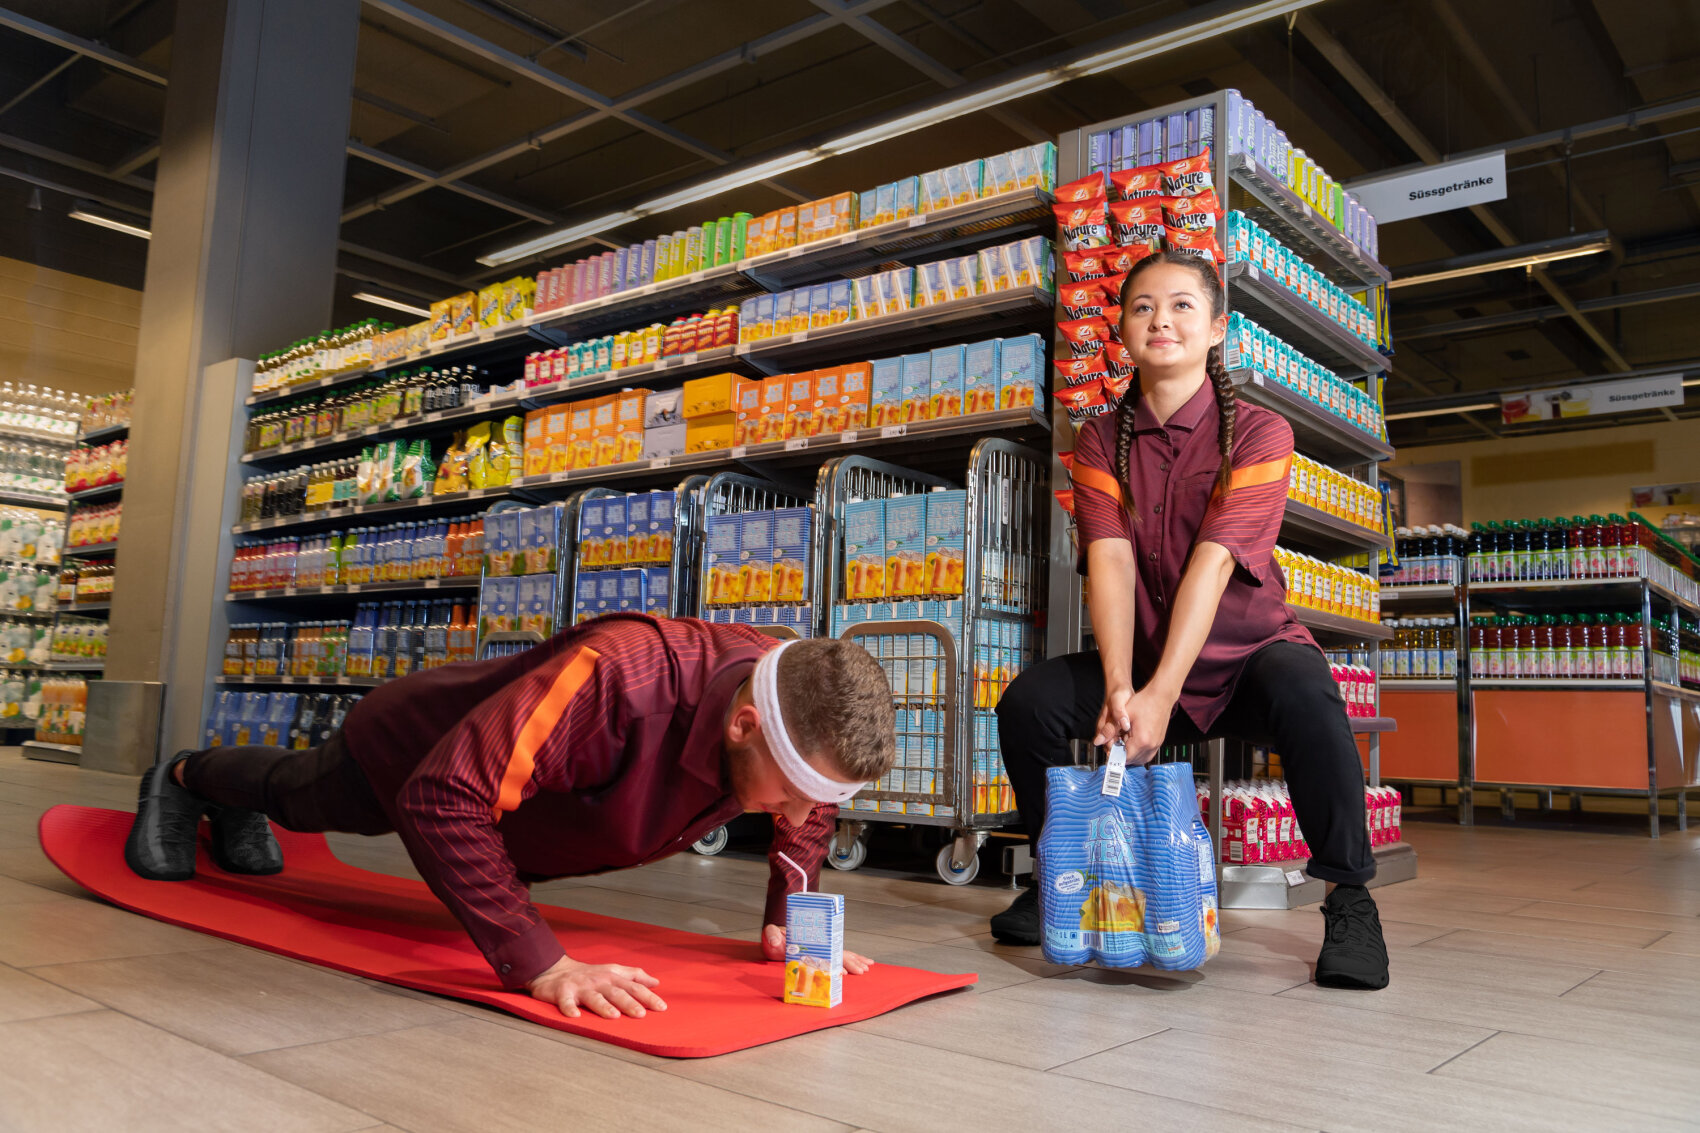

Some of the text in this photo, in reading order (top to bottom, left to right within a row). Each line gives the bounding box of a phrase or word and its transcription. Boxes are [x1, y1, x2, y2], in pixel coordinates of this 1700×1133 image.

[1167, 172, 1204, 193] Nature
[1409, 176, 1494, 201] Süssgetränke
[1169, 213, 1207, 229] Nature
[1062, 225, 1098, 242] Nature
[1119, 223, 1158, 241] Nature
[1064, 305, 1102, 320] Nature
[1609, 390, 1676, 402] Süssgetränke
[1068, 405, 1104, 419] Nature
[1088, 814, 1134, 843] ICE
[1084, 840, 1137, 865] TEA
[793, 911, 825, 927] ICE
[791, 926, 827, 943] TEA
